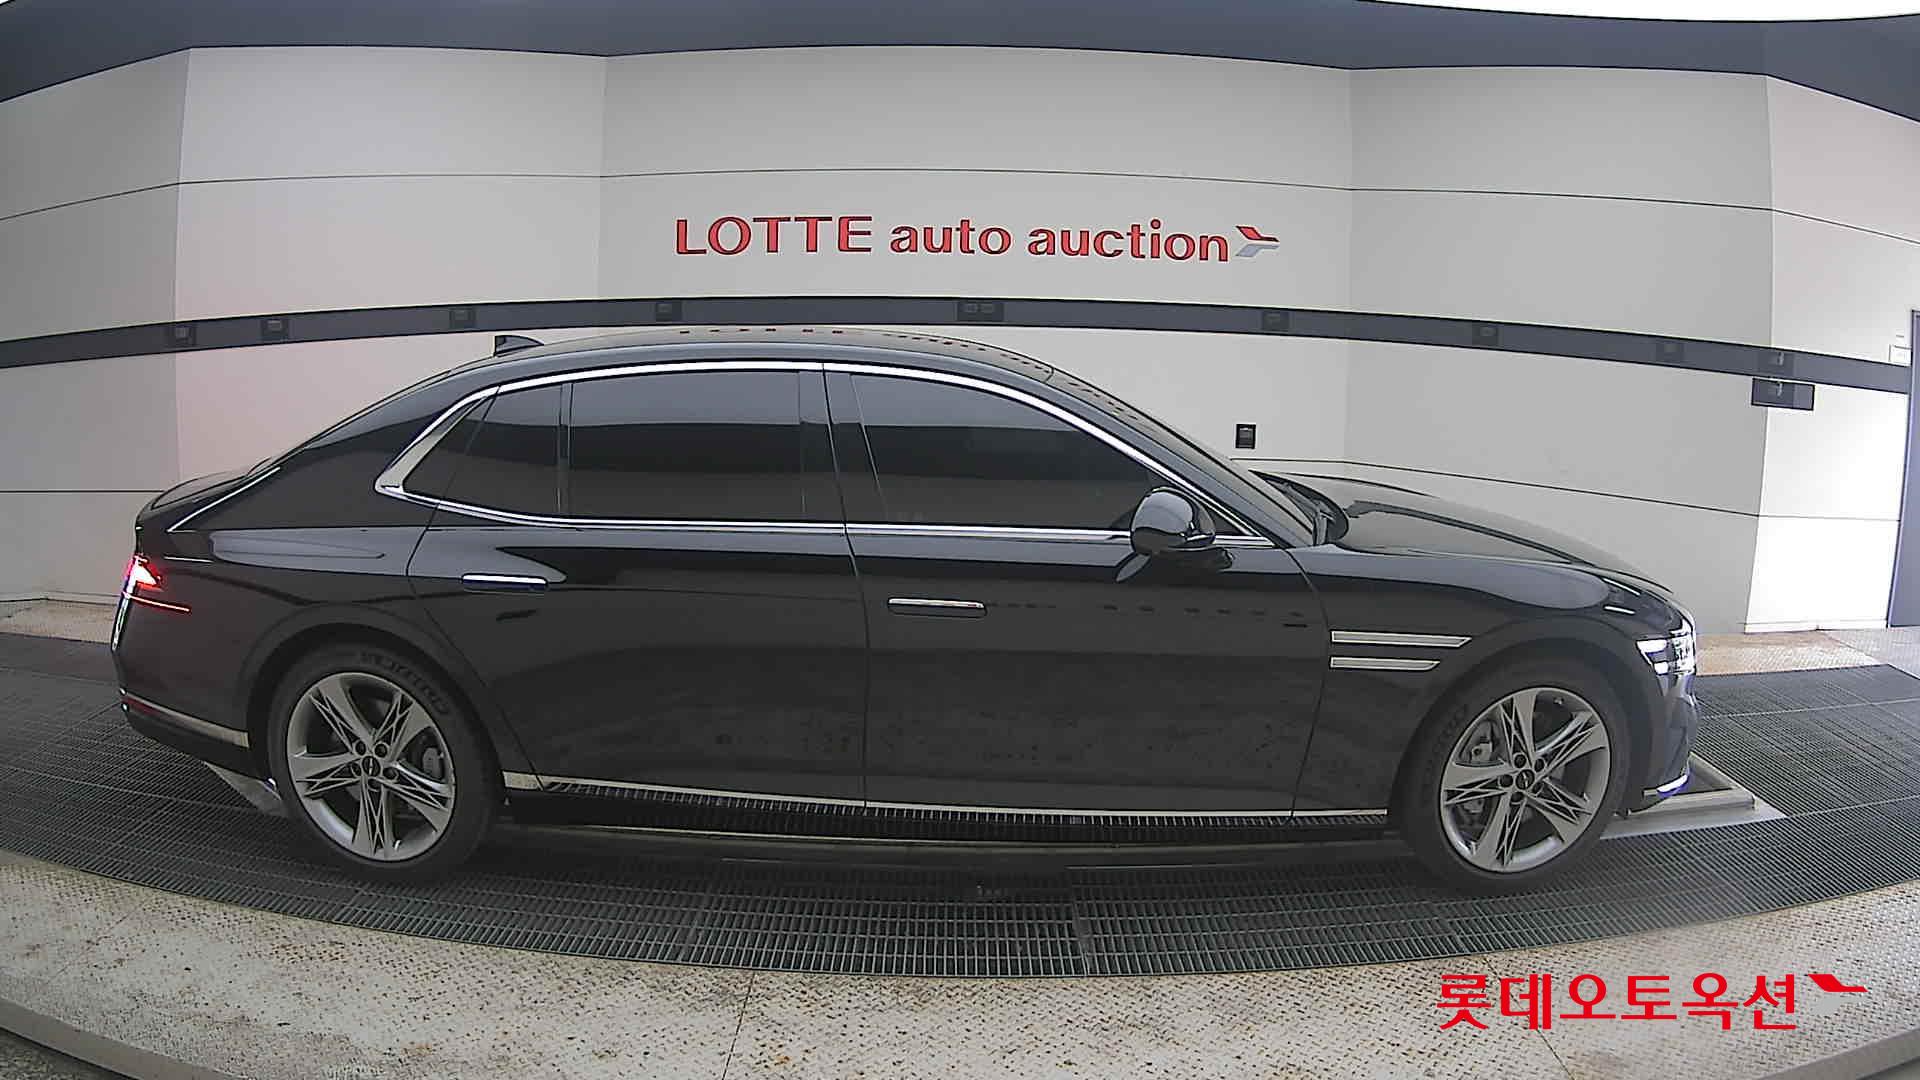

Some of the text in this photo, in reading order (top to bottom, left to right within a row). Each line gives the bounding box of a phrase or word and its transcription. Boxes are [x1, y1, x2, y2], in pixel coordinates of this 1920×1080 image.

[675, 216, 1230, 262] LOTTE auto auction
